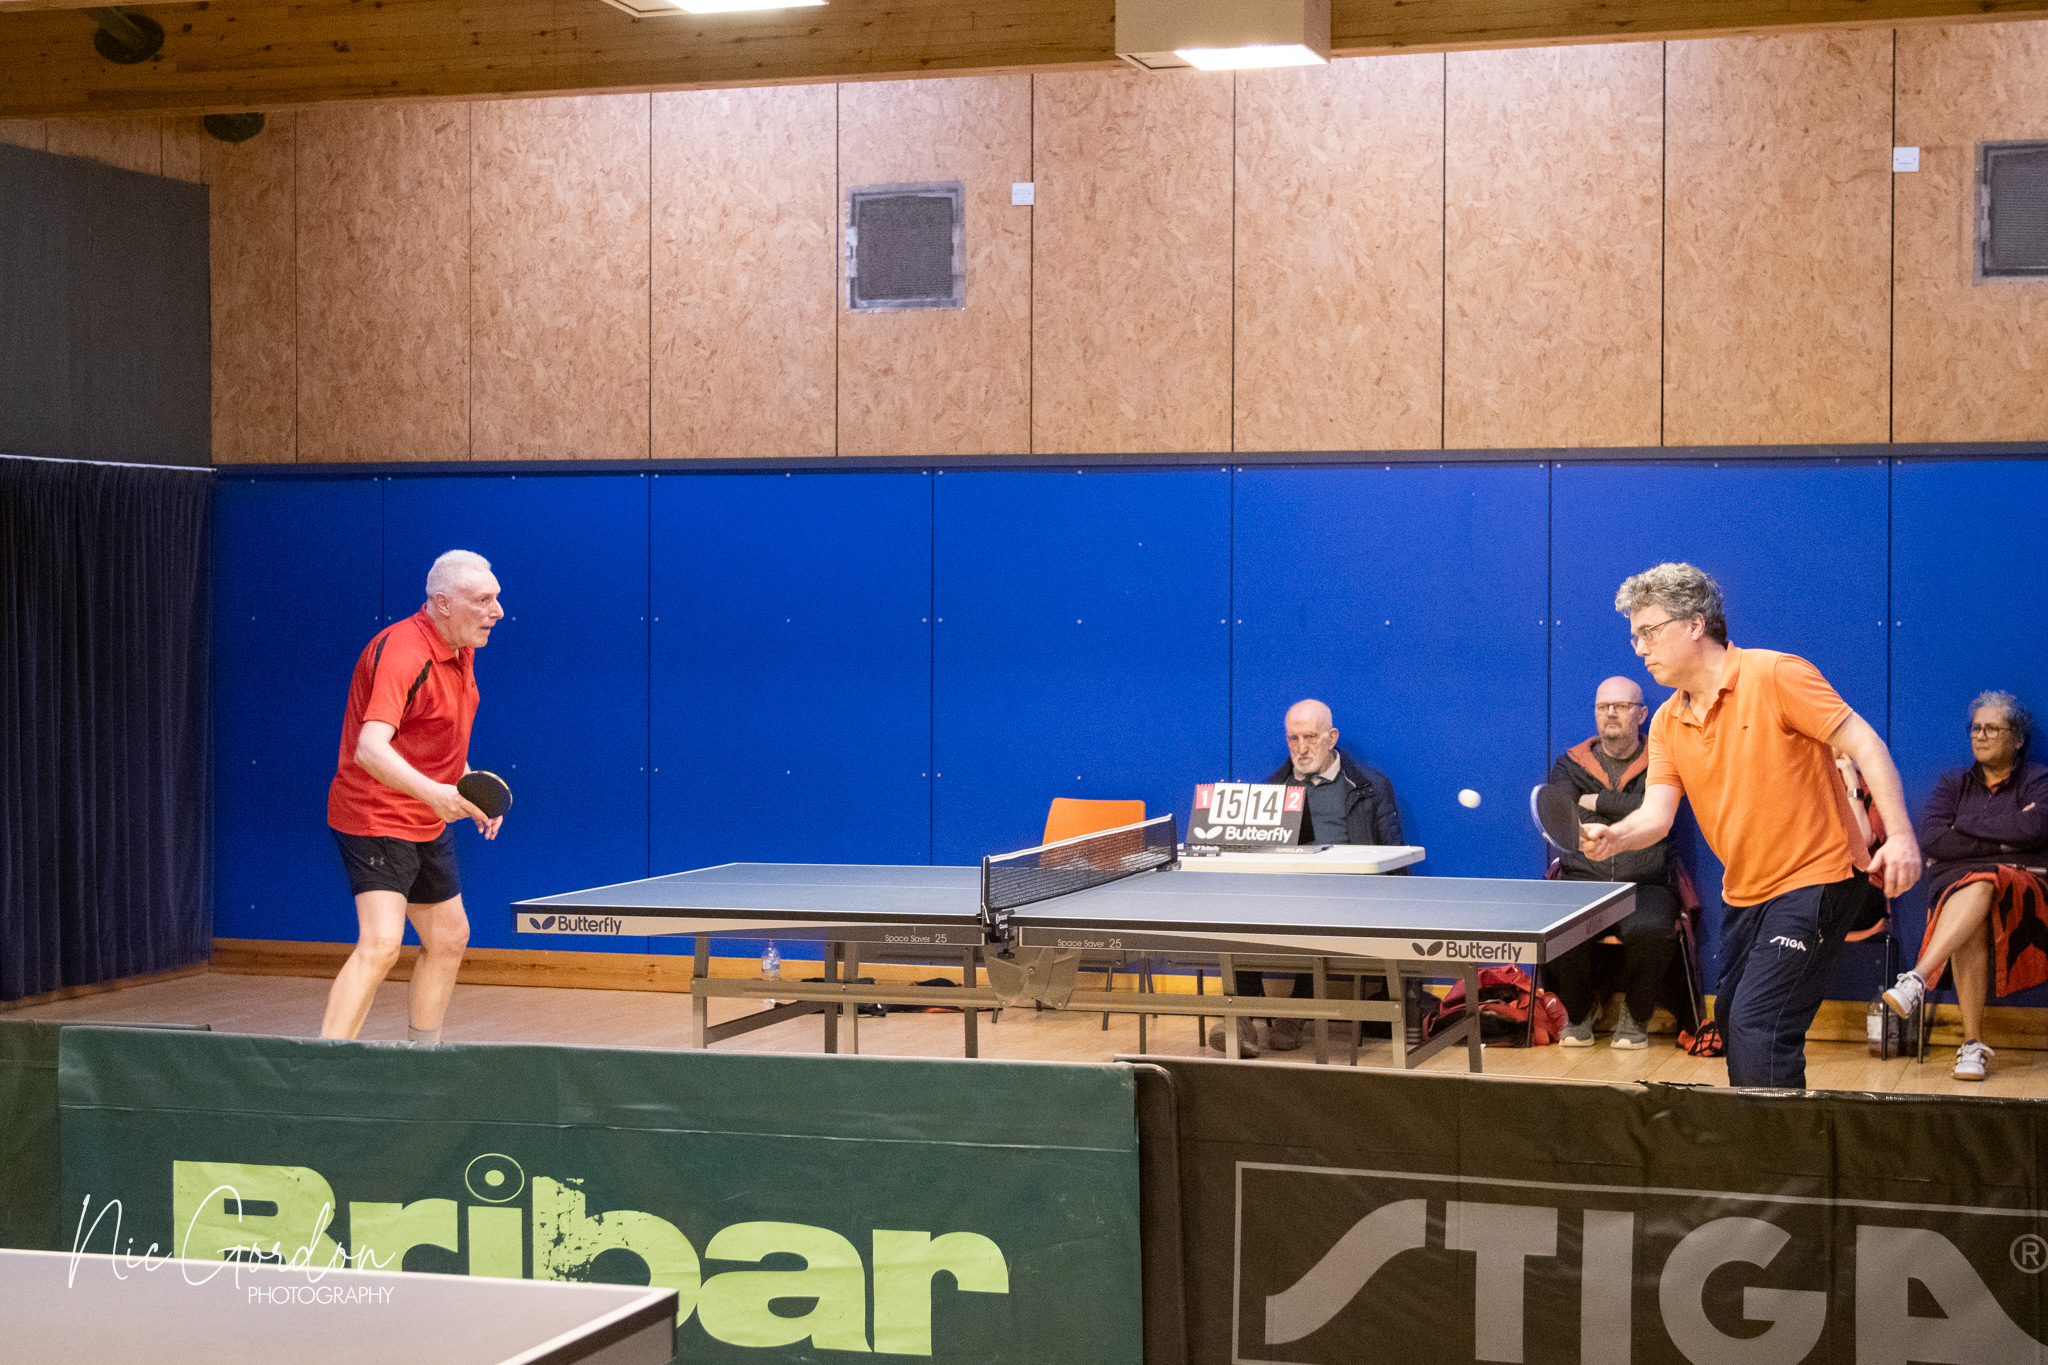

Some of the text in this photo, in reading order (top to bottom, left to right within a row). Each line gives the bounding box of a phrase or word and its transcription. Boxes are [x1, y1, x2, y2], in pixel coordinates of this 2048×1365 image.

[1200, 789, 1301, 820] 1 15 14 2
[1224, 826, 1293, 843] Butterfly
[558, 915, 622, 935] Butterfly
[885, 933, 947, 943] Space Saver 25
[1057, 938, 1122, 948] Space Saver 25
[1769, 935, 1807, 952] STIGA
[1446, 941, 1522, 962] Butterfly
[173, 1153, 1009, 1356] Bribar
[1265, 1199, 2048, 1365] STIGA
